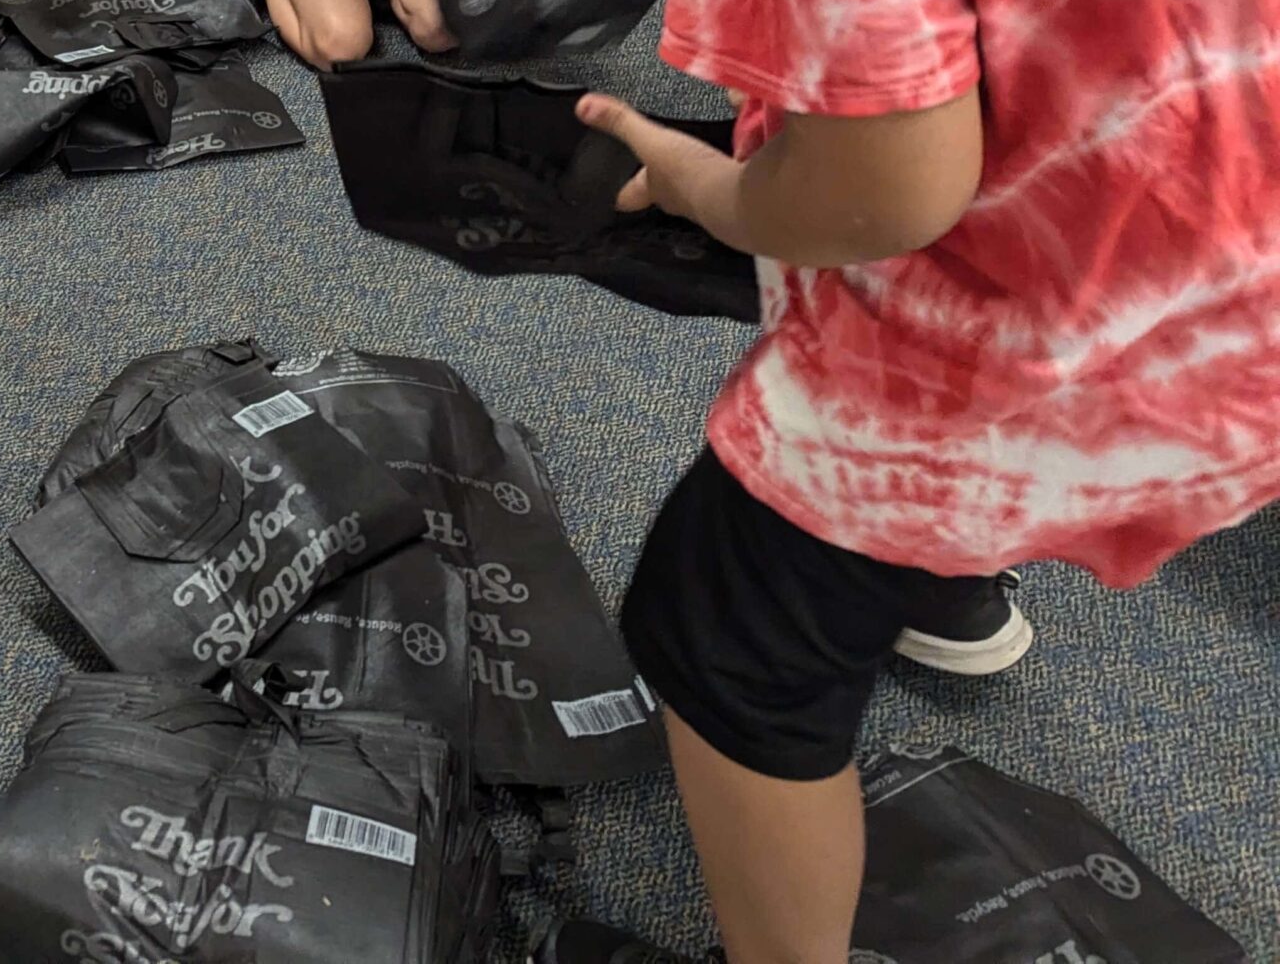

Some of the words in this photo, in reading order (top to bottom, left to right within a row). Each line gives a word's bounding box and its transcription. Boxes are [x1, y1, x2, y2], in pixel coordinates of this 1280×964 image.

[173, 539, 256, 608] You
[249, 482, 307, 574] for
[192, 511, 368, 667] Shopping
[469, 609, 532, 648] Yo
[120, 804, 296, 888] Thank
[83, 863, 197, 935] You
